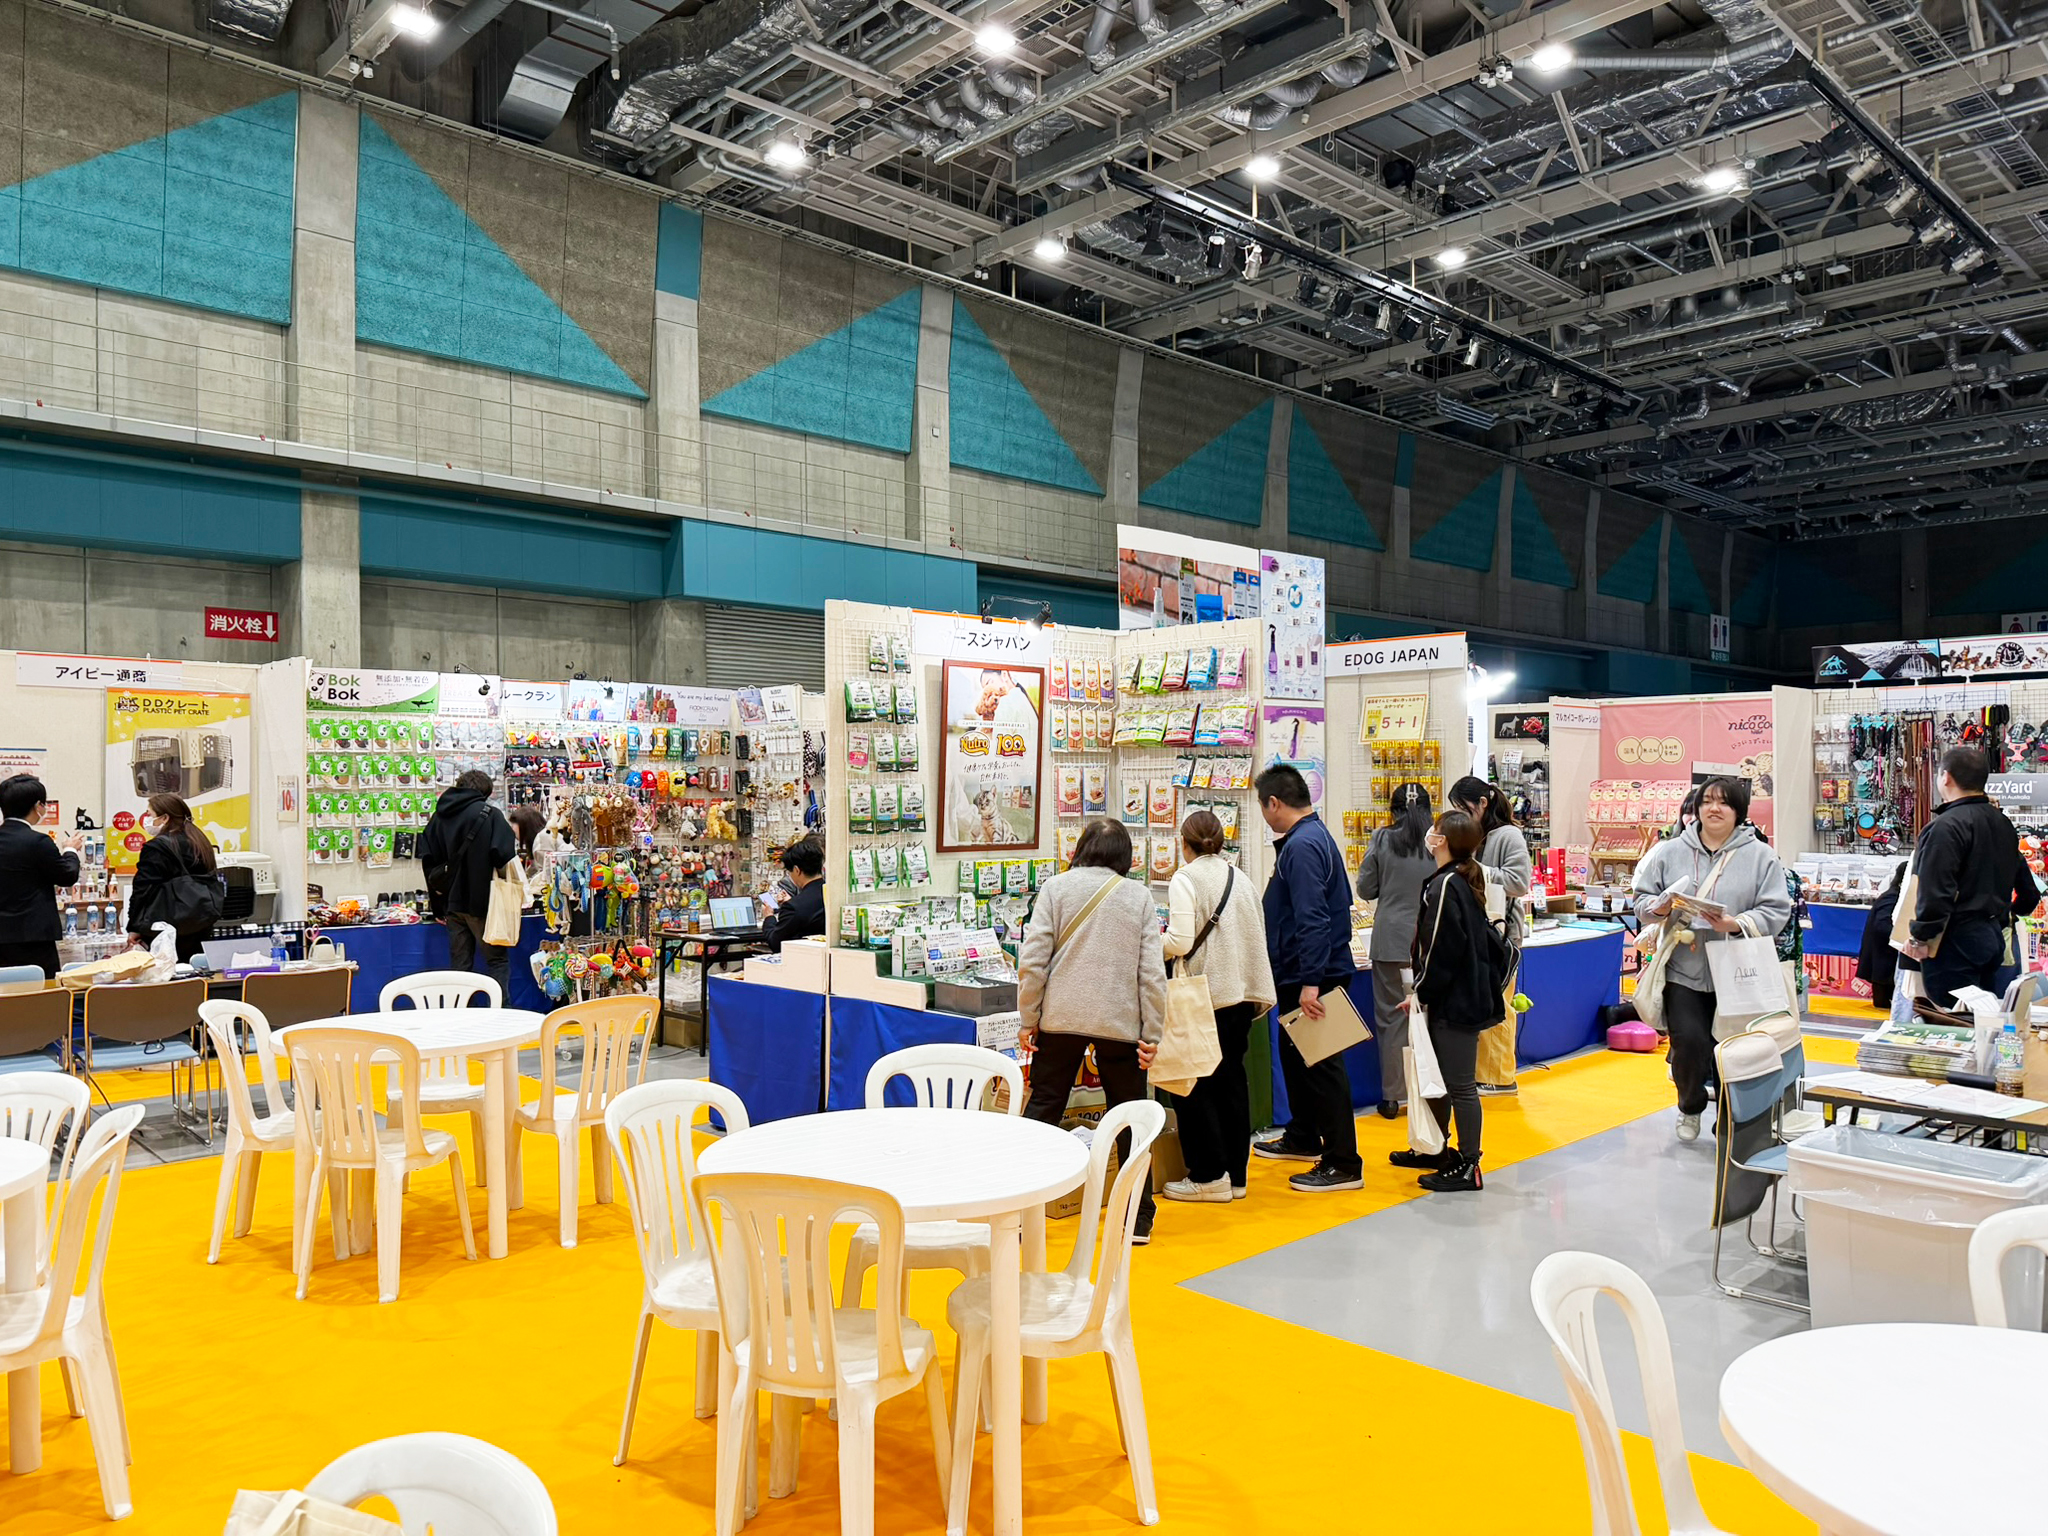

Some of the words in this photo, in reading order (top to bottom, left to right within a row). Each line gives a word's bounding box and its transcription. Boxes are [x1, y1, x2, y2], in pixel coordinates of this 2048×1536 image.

[210, 615, 263, 634] 消火栓
[943, 631, 1031, 652] ースジャパン
[1345, 652, 1384, 667] EDOG
[1390, 647, 1439, 663] JAPAN
[328, 674, 361, 687] Bok
[328, 688, 360, 701] Bok
[703, 693, 714, 701] best
[1381, 716, 1391, 729] 5
